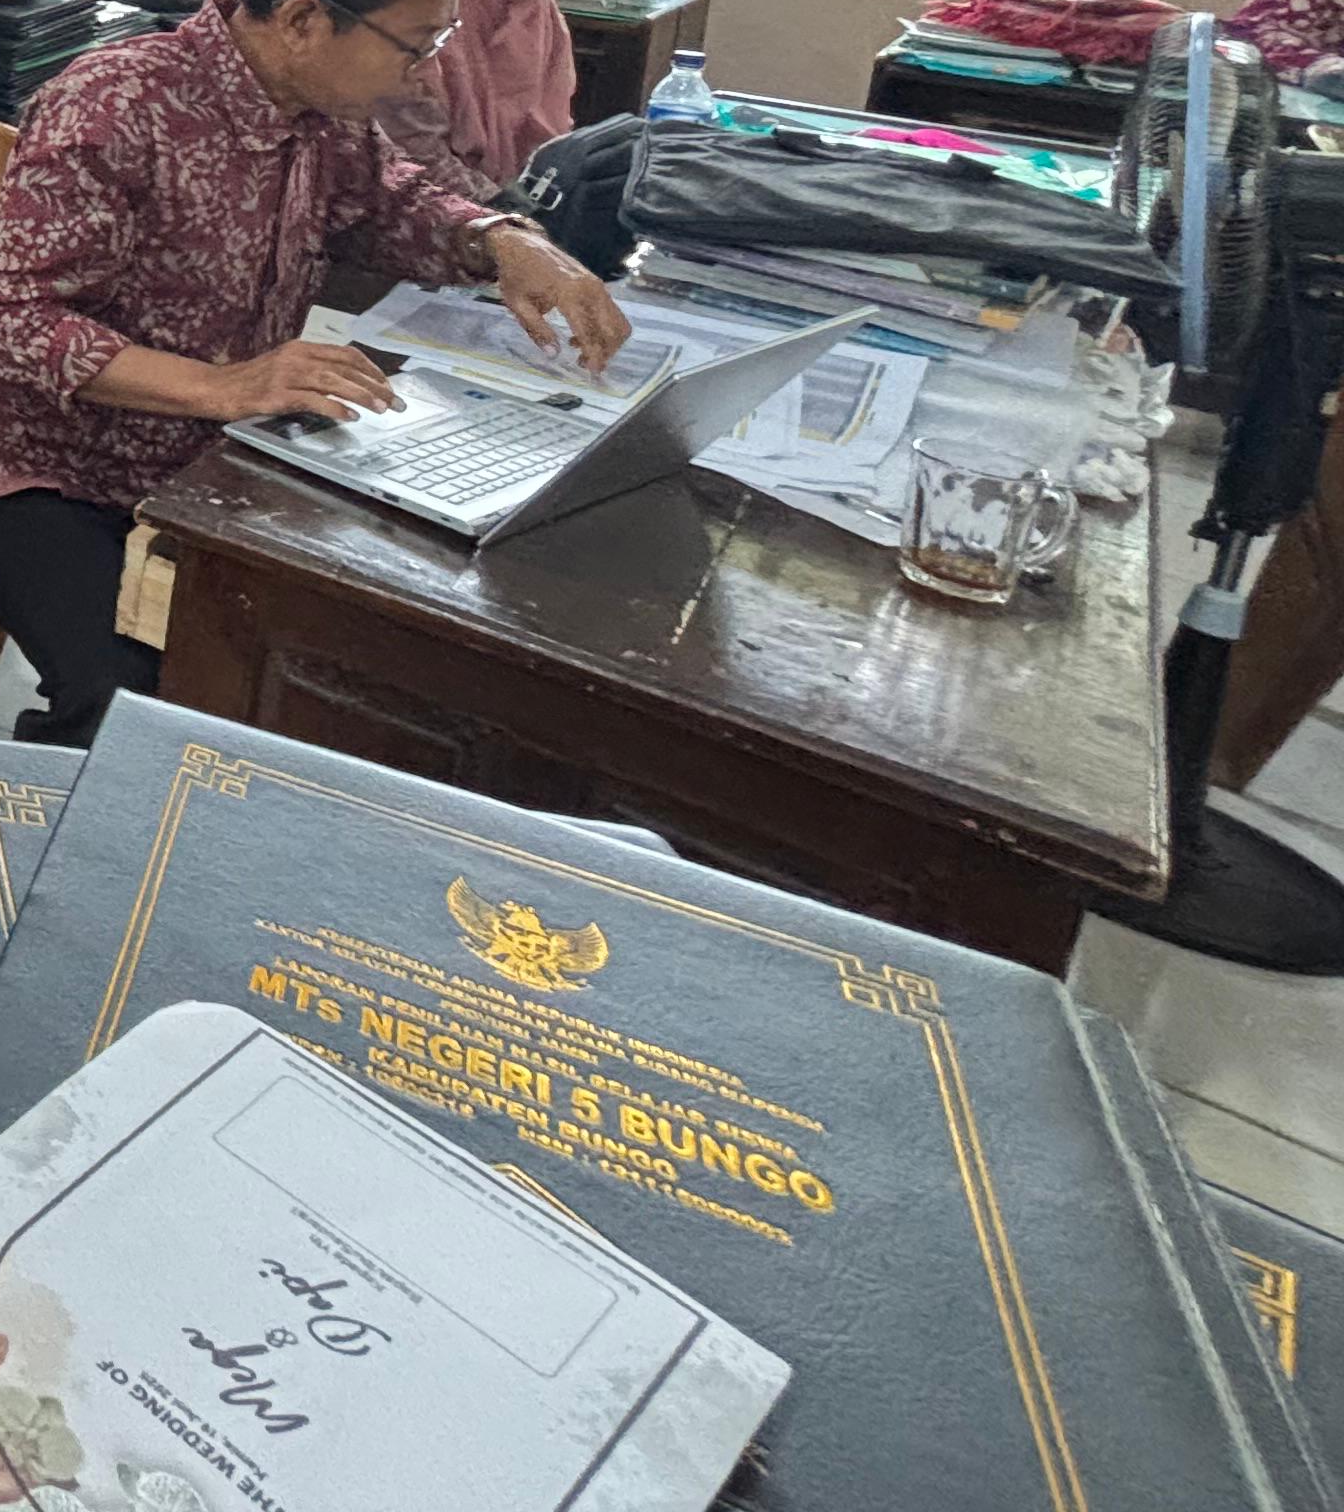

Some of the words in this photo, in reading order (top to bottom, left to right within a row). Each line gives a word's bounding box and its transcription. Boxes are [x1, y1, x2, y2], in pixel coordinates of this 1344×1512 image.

[247, 963, 344, 1024] MTs
[359, 1005, 554, 1109] NEGERI
[570, 1086, 603, 1126] 5
[618, 1102, 837, 1215] BUNGO
[367, 1045, 551, 1131] KABUPATEN
[558, 1119, 680, 1182] BUNGO
[95, 1360, 129, 1385] OF
[180, 1326, 310, 1434] Mega
[127, 1383, 236, 1479] WEDDING
[236, 1475, 286, 1512] HE
